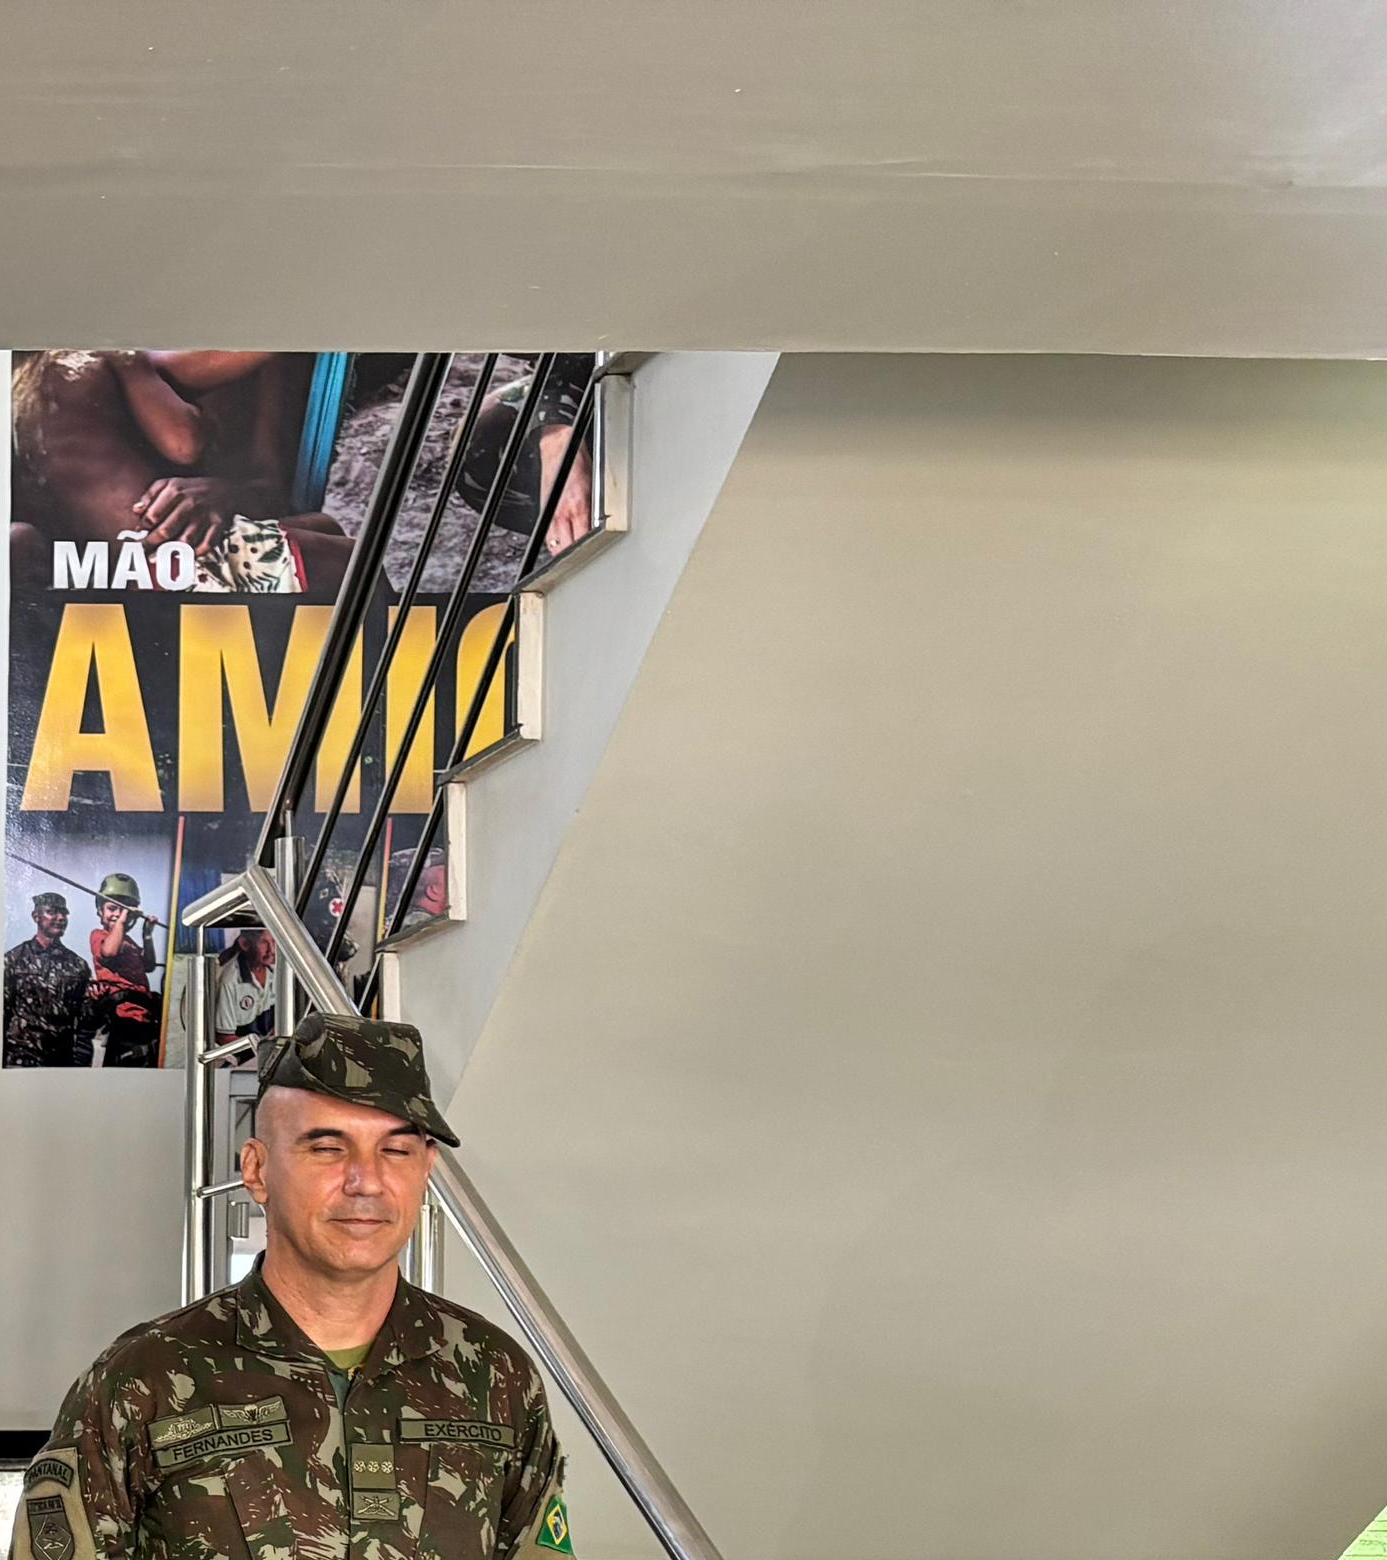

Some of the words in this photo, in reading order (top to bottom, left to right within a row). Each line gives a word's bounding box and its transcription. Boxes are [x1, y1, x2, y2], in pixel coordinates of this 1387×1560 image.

[53, 530, 196, 590] MÃO
[173, 1429, 273, 1460] FERNANDES
[424, 1423, 502, 1441] EXÉRCITO
